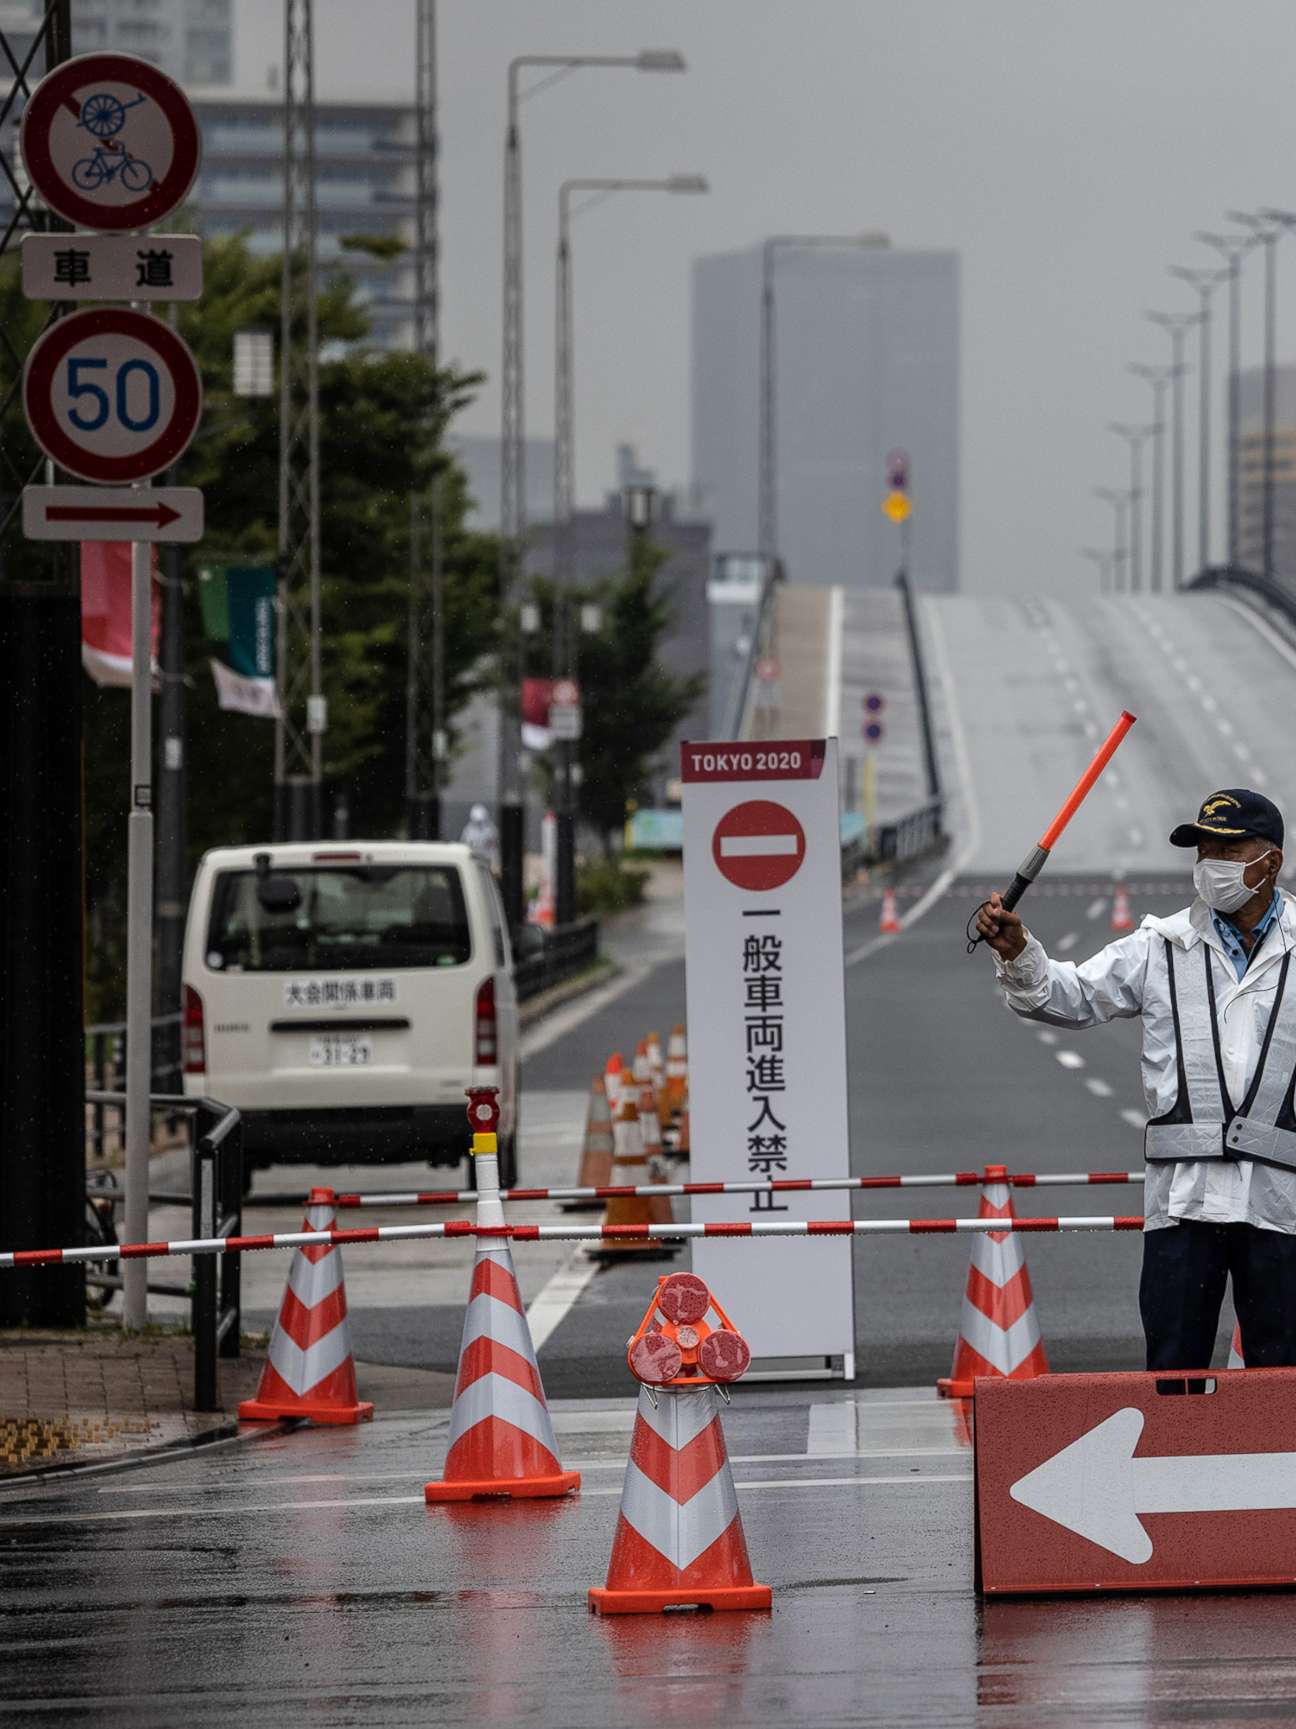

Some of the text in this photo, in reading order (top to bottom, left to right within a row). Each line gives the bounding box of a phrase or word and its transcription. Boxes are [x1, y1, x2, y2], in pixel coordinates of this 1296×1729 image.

[53, 248, 174, 287] 車道
[67, 357, 160, 432] 50
[691, 752, 801, 772] TOKYO 2020
[741, 908, 789, 1213] 一般車両進入禁止
